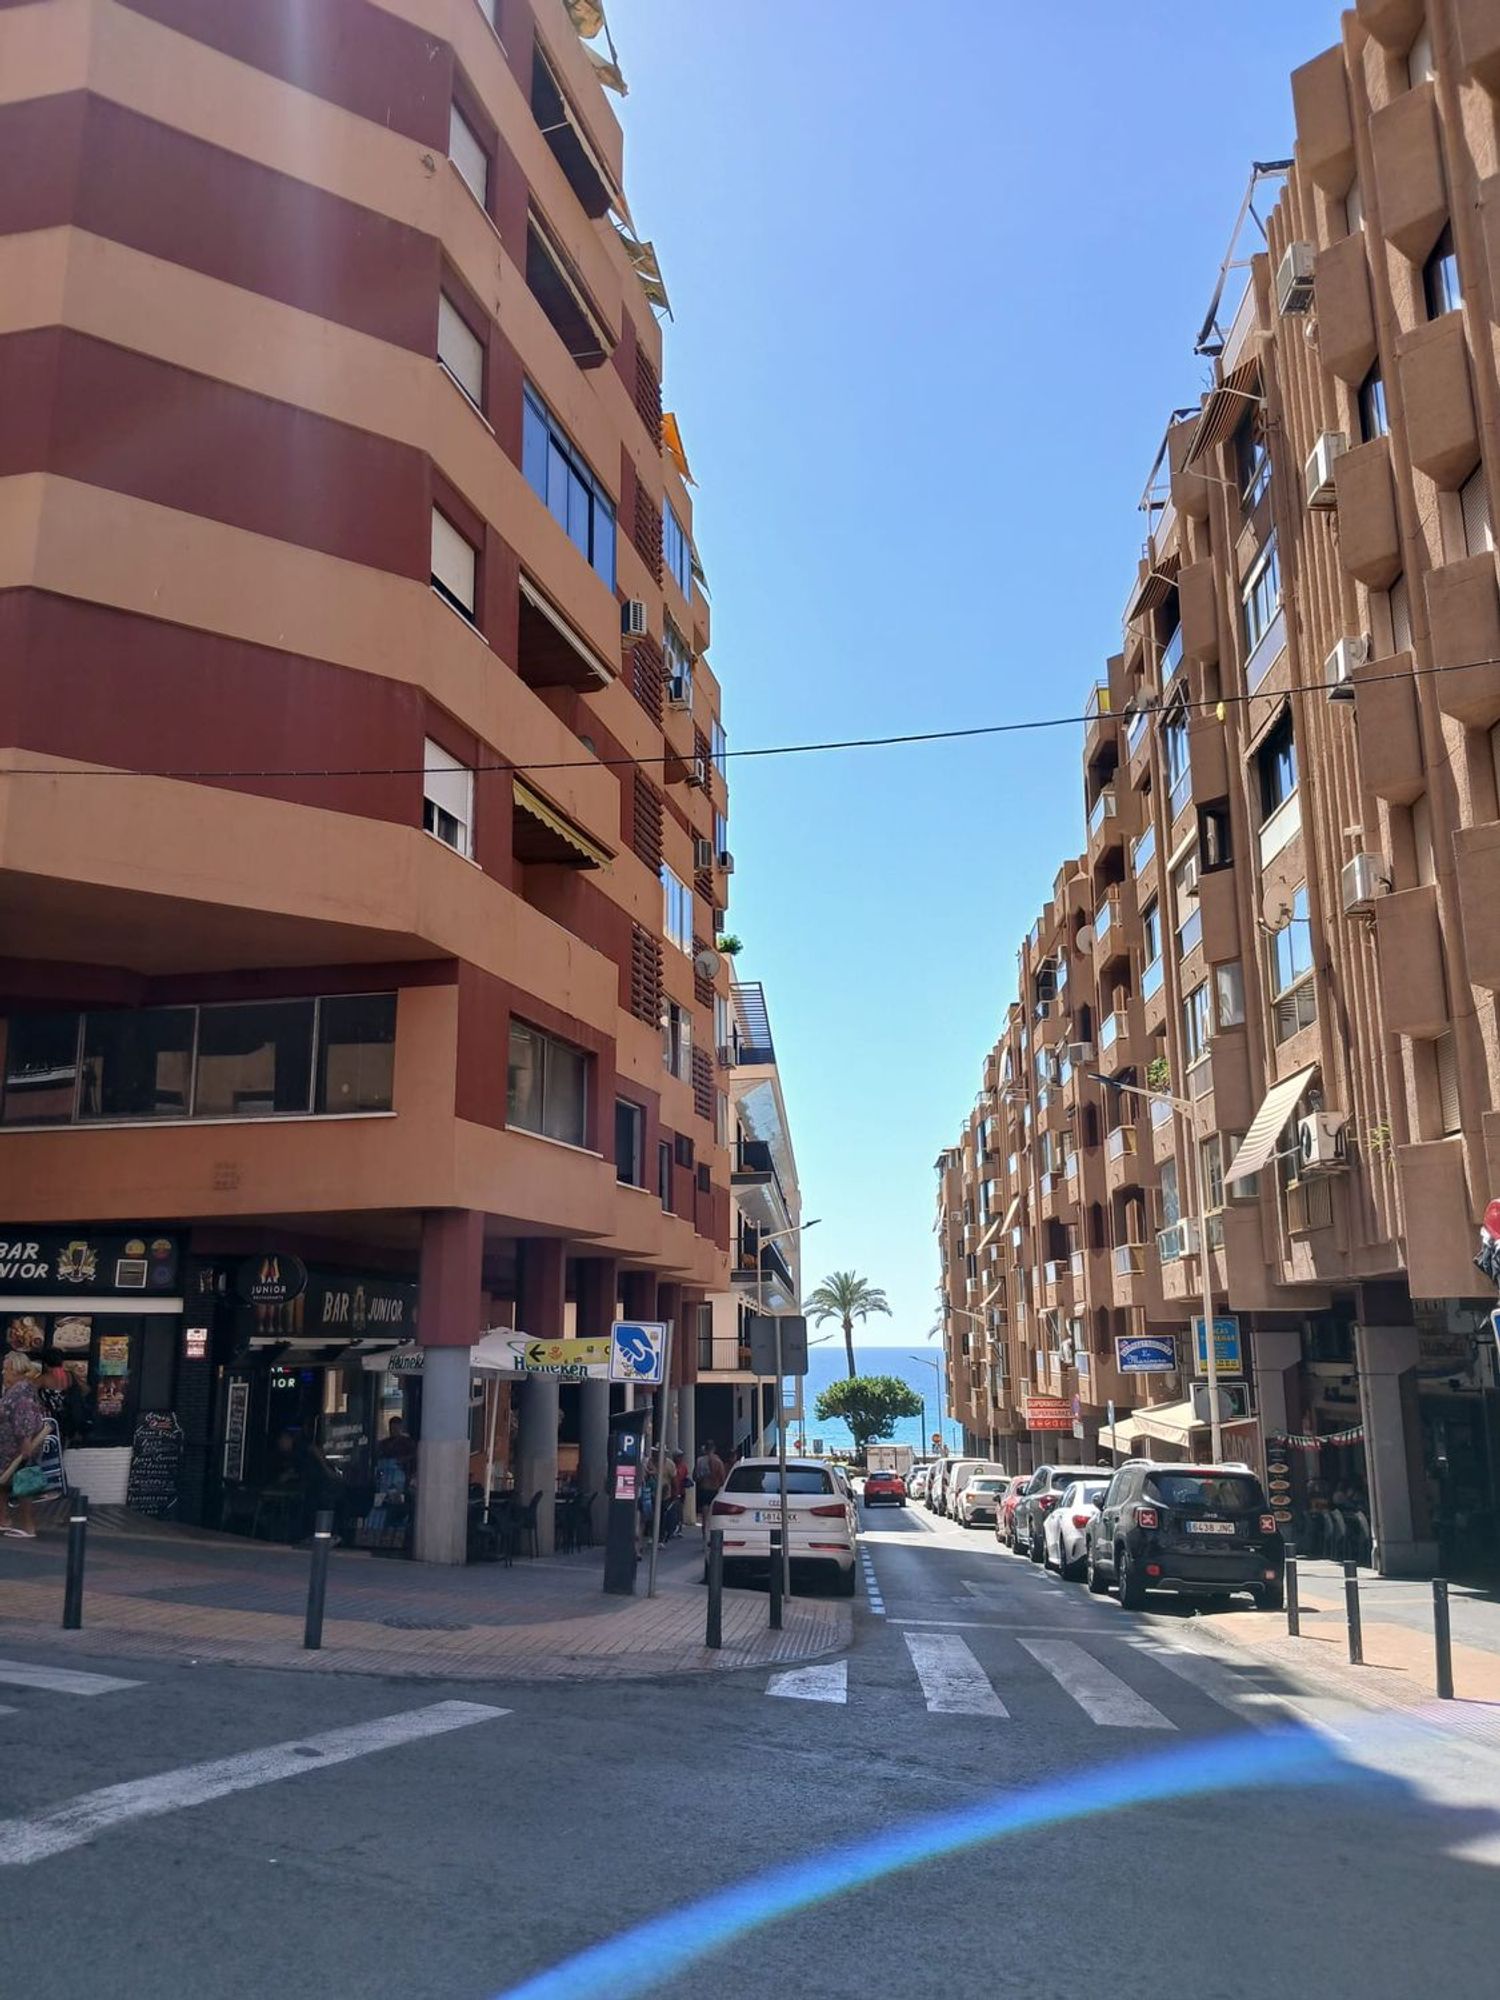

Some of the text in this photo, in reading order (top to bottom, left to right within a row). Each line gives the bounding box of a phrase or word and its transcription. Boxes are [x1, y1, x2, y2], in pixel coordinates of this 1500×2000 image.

[0, 1242, 40, 1260] BAR
[0, 1263, 49, 1279] NIOR
[251, 1285, 287, 1295] JUNIOR
[322, 1291, 404, 1322] BAR JUNIOR
[624, 1435, 634, 1452] P
